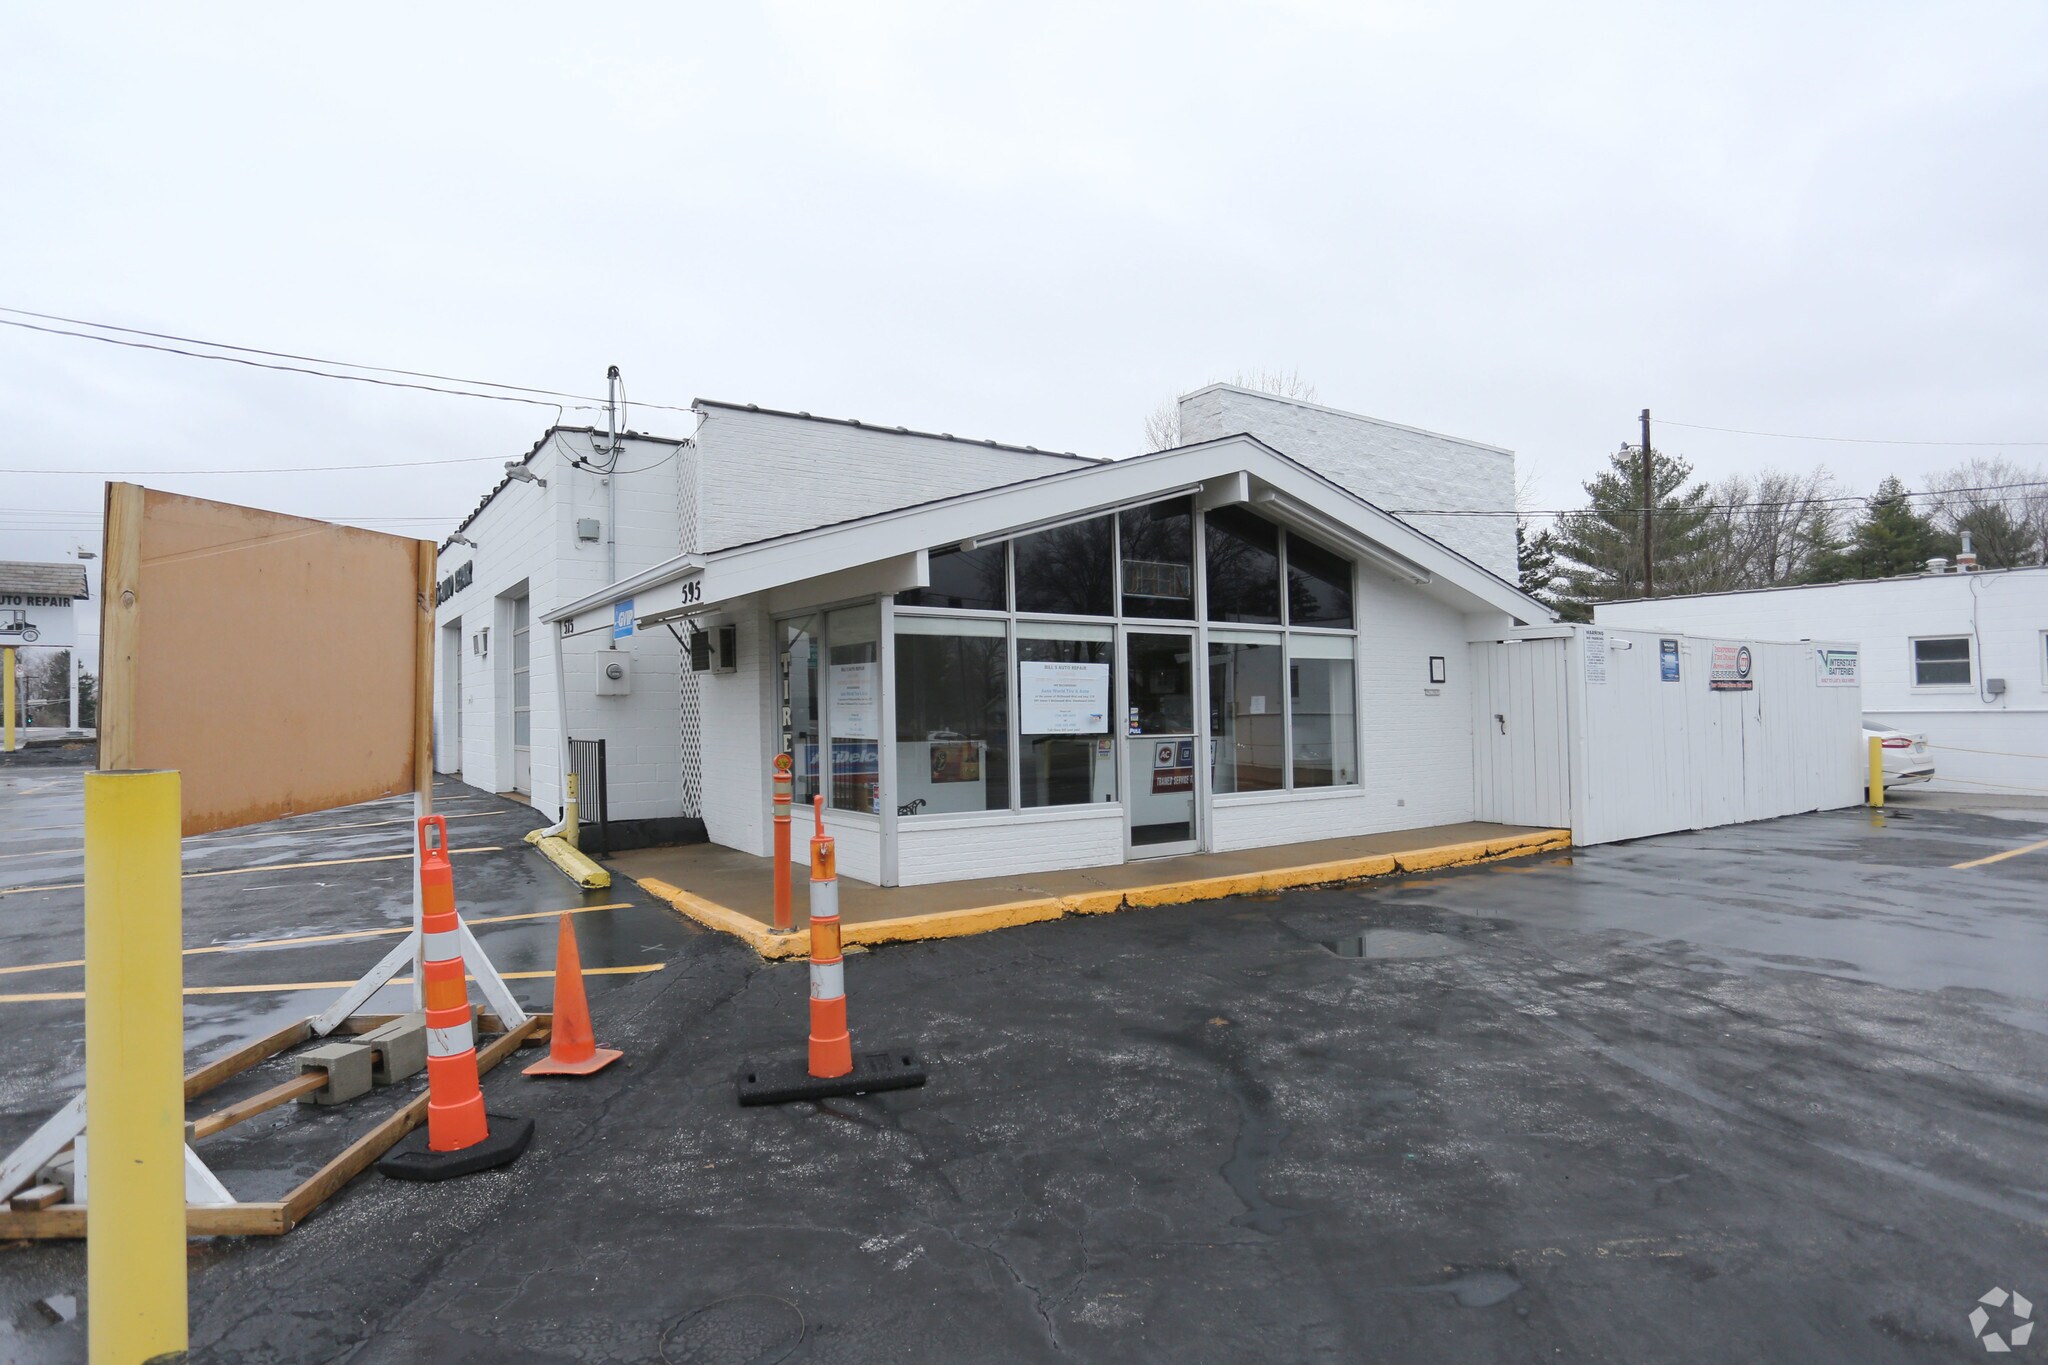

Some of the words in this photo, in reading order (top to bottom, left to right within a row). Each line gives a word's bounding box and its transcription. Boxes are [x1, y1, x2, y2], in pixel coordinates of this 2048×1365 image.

[681, 580, 701, 605] 595
[27, 596, 71, 607] REPAIR
[1829, 658, 1856, 667] INTERSTATE
[1829, 667, 1854, 675] BATTERIES
[780, 652, 793, 775] TIRE
[1160, 750, 1170, 759] AC
[1173, 775, 1189, 785] SERVICE
